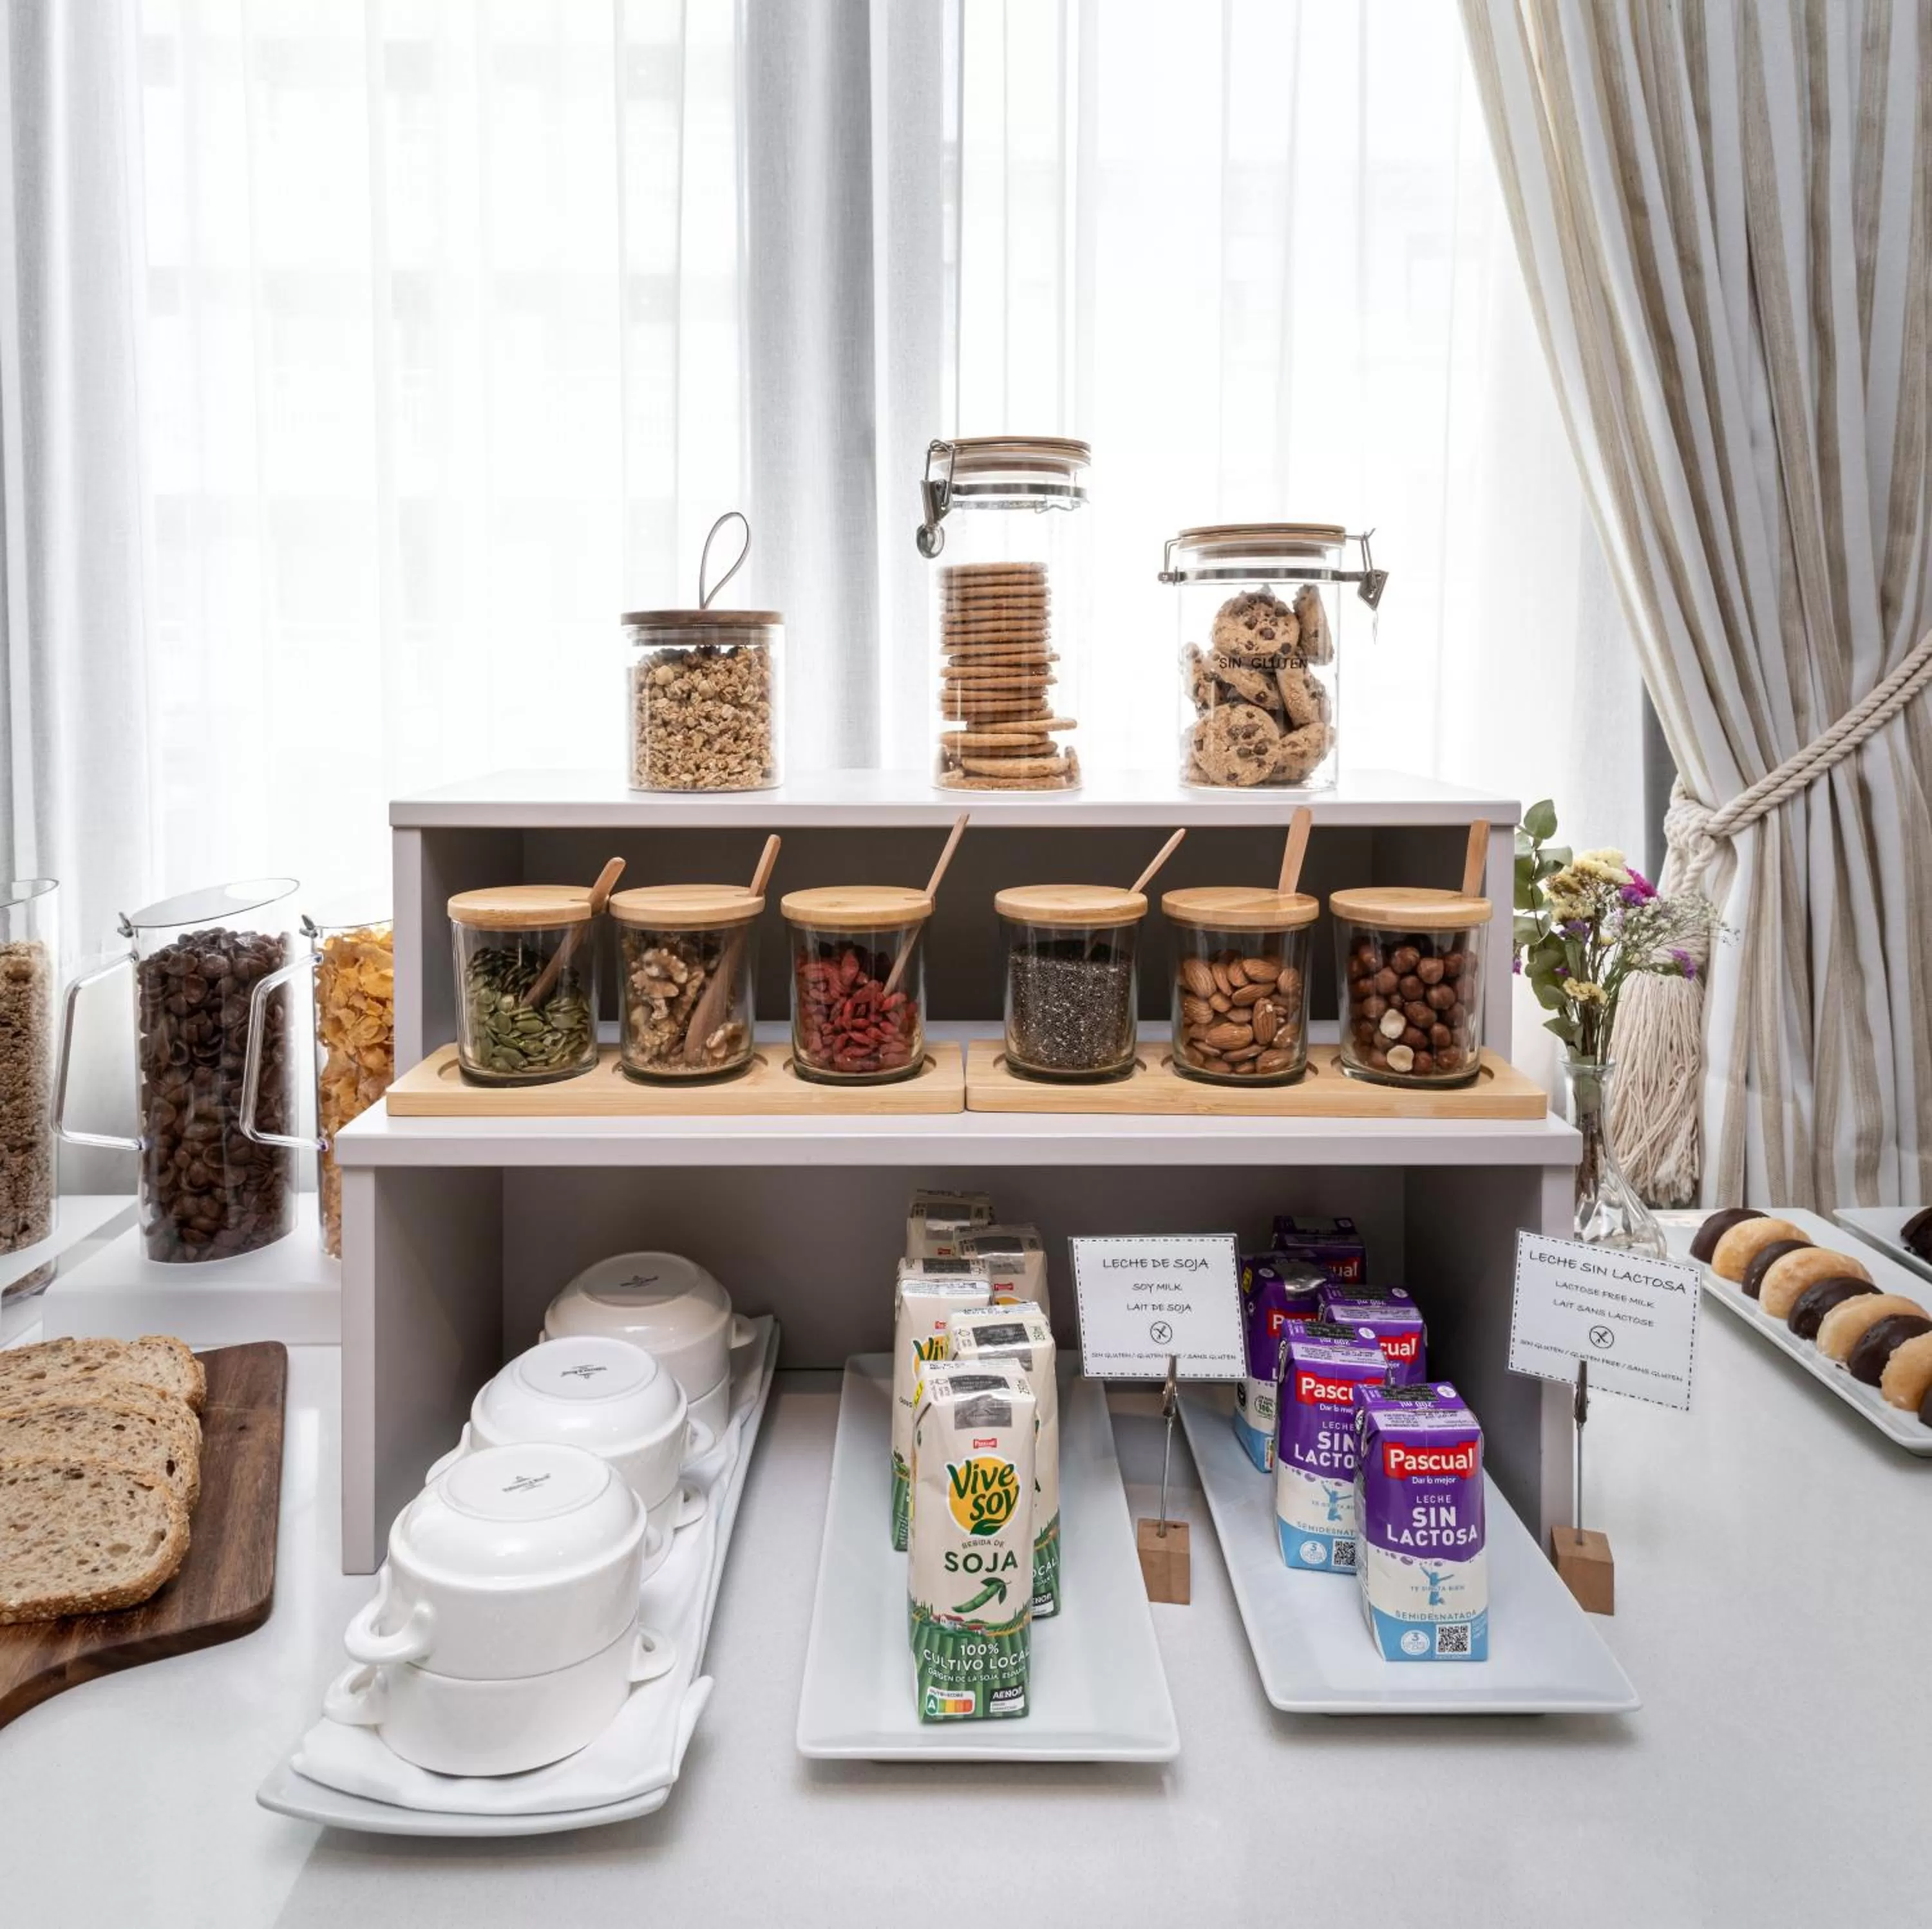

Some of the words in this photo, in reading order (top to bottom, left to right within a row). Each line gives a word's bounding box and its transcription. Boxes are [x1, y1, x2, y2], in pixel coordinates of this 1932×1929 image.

[1219, 657, 1242, 669] SIN
[1251, 657, 1307, 670] GLUTEN
[1103, 1259, 1148, 1268] LECHE
[1151, 1259, 1170, 1268] DE
[1173, 1258, 1209, 1271] SOJA
[1530, 1250, 1577, 1268] LECHE
[1580, 1263, 1607, 1276] SIN
[1613, 1269, 1685, 1294] LACTOSA
[1132, 1283, 1154, 1294] SOY
[1555, 1280, 1599, 1296] LACTOSE
[1602, 1291, 1627, 1302] FREE
[1629, 1297, 1656, 1308] MILK
[1167, 1304, 1191, 1313] SOJA
[1553, 1299, 1575, 1309] LAIT
[1577, 1305, 1605, 1317] SANS
[1608, 1311, 1654, 1327] LACTOSE
[1302, 1377, 1353, 1401] Pasc
[1322, 1422, 1354, 1431] LECHE
[1317, 1431, 1354, 1452] SIN
[1294, 1443, 1354, 1469] LACTO
[1390, 1448, 1473, 1469] Pascual
[947, 1460, 1015, 1499] Vive
[1426, 1476, 1432, 1484] lo
[1435, 1476, 1455, 1486] mejor
[1417, 1494, 1451, 1503] LECHE
[1412, 1507, 1456, 1527] SIN
[1297, 1521, 1354, 1536] SEMIDESNAT
[1387, 1524, 1477, 1546] LACTOSA
[945, 1550, 1018, 1574] SOJA
[1396, 1610, 1476, 1621] SEMIDESNATADA
[961, 1643, 999, 1655] 100%
[923, 1649, 983, 1671] CULTIVO
[928, 1667, 953, 1682] ORIGEN
[928, 1698, 936, 1710] A
